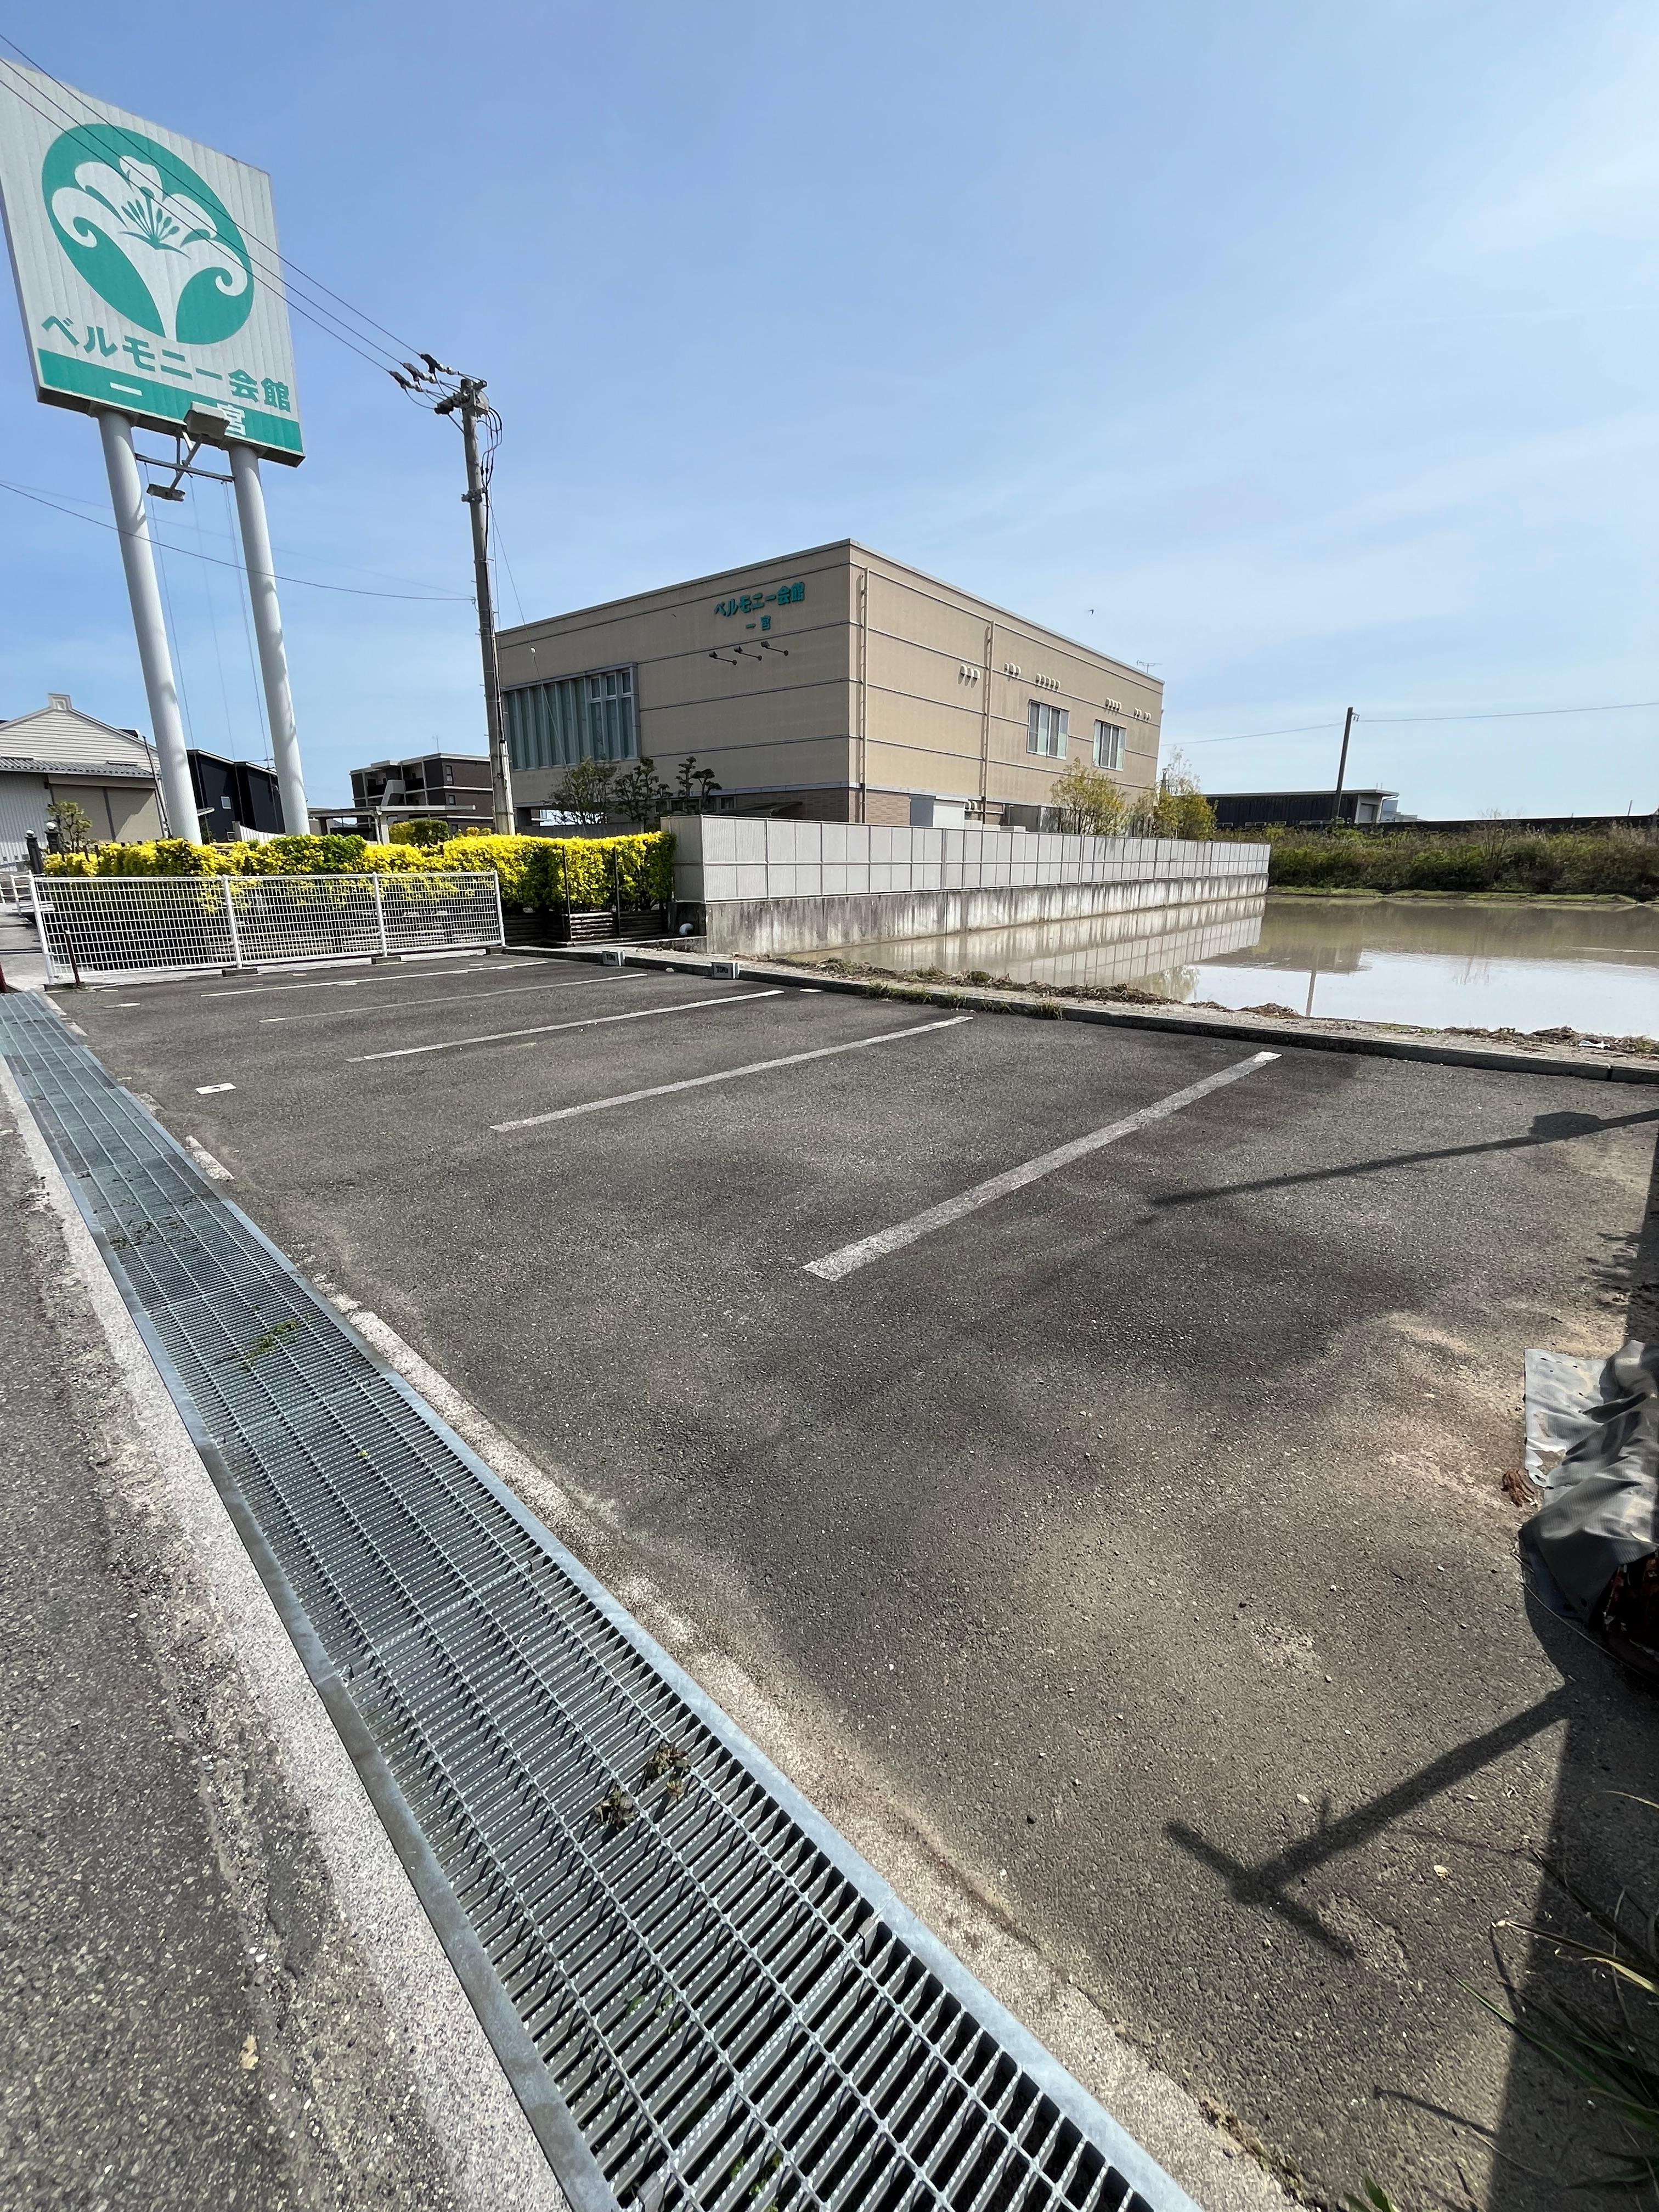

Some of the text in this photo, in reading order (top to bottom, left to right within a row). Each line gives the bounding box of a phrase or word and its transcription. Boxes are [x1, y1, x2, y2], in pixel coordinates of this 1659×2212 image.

[41, 315, 291, 413] ベルモニー会館
[714, 582, 805, 617] ベルモニー会館
